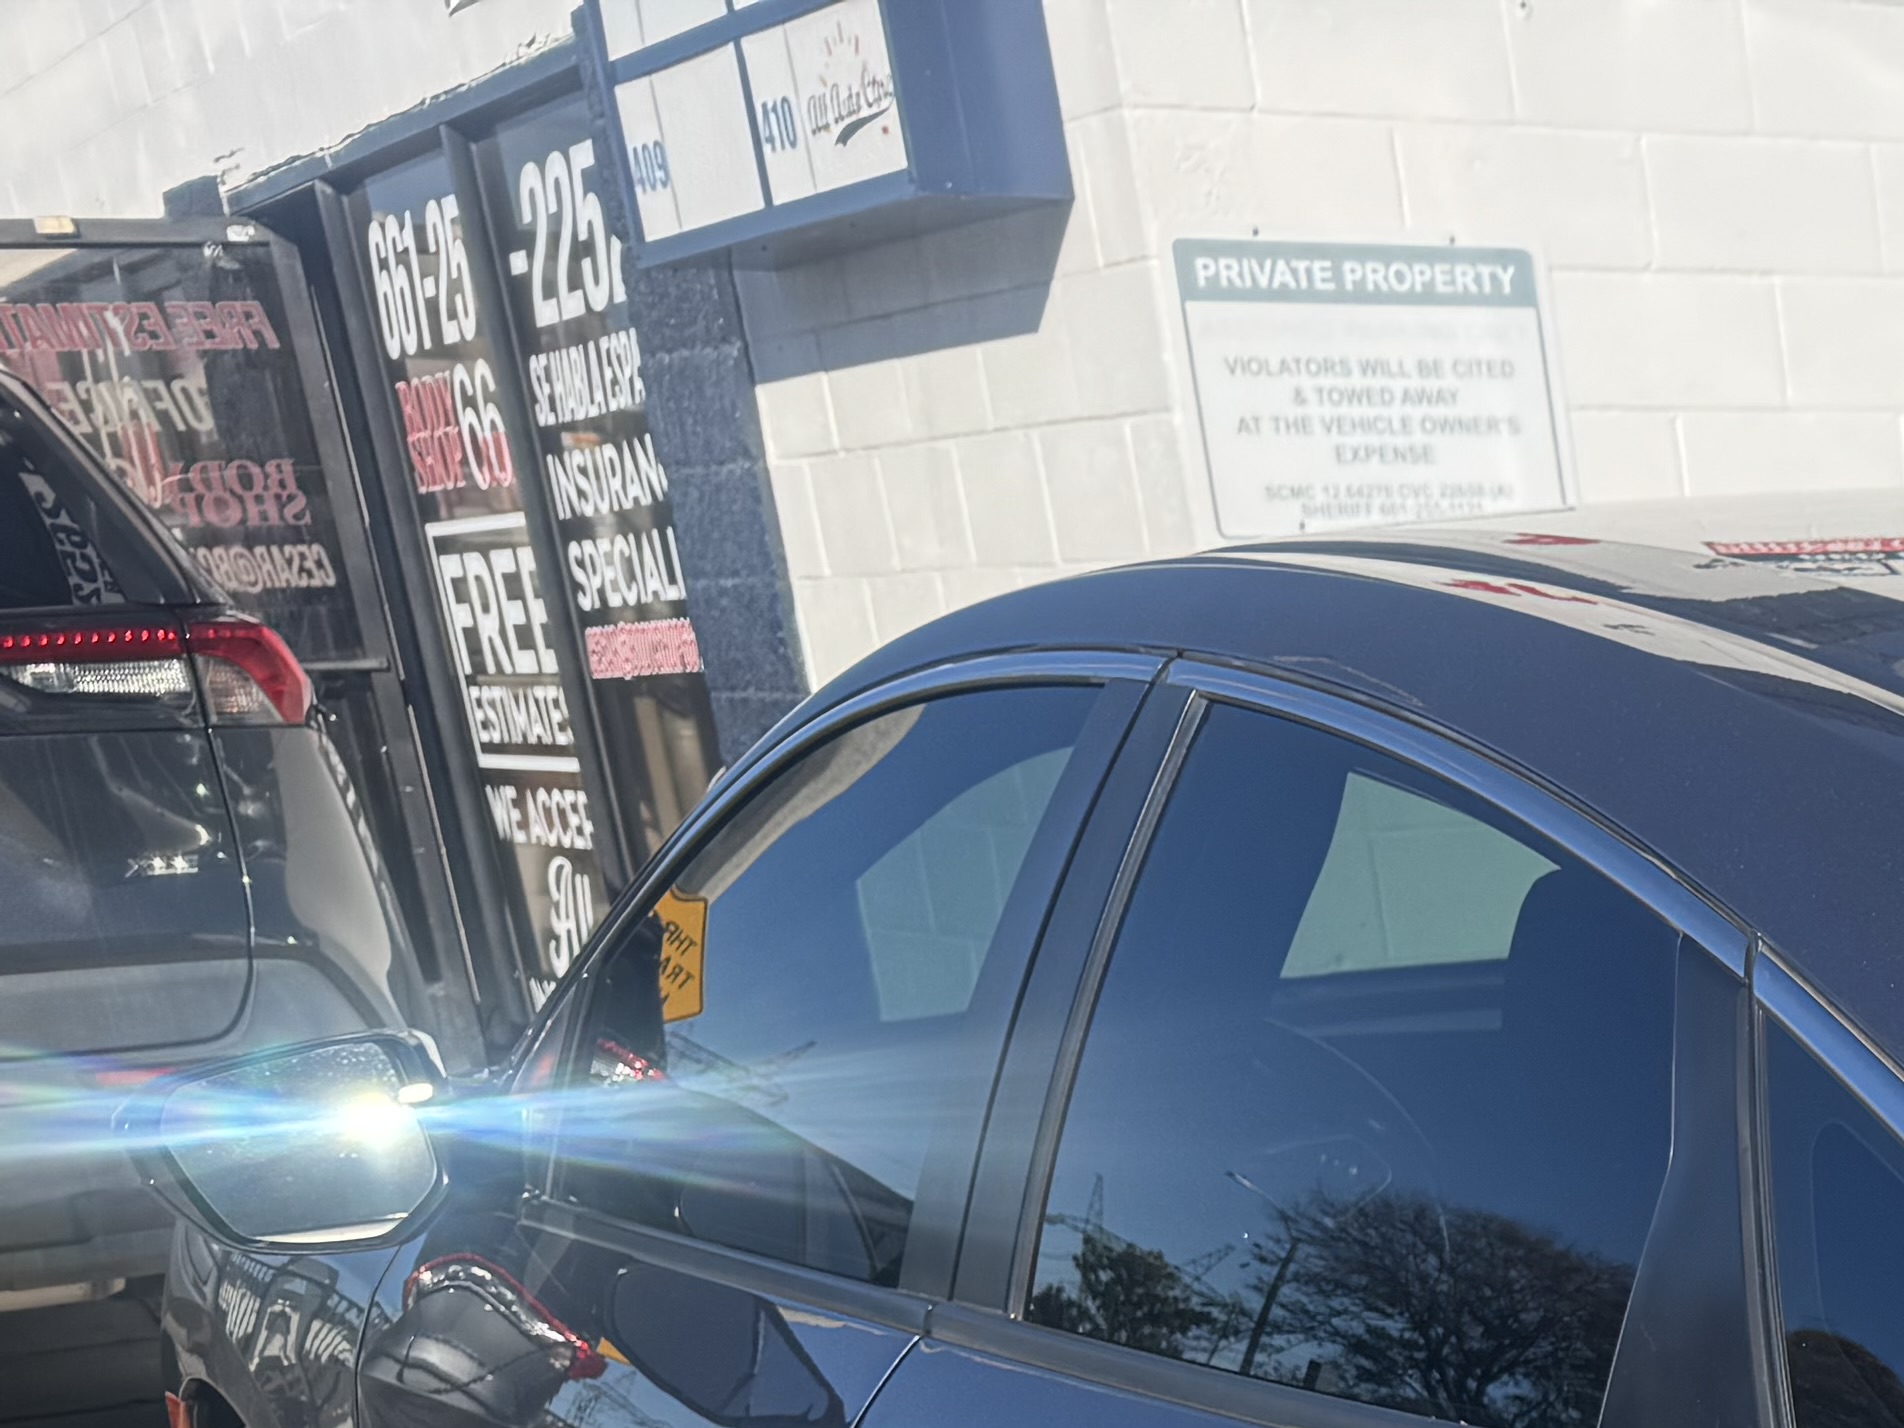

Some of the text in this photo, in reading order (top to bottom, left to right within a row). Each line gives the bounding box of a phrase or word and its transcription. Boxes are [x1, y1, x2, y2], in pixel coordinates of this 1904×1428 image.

[757, 95, 798, 154] 410
[631, 140, 669, 196] 409
[368, 194, 477, 360] 661-25
[1195, 257, 1515, 295] PRIVATE PROPERTY
[530, 328, 646, 427] SE HABLA ESPA
[1224, 356, 1515, 379] VIOLATORS WILL BE CITED
[396, 371, 454, 440] BODY
[454, 358, 514, 491] 66
[1237, 416, 1521, 438] AT THE VEHICLE OWNER'S
[1294, 387, 1459, 408] & TOWED AWAY
[1336, 444, 1436, 466] EXPENSE
[569, 527, 686, 611] SPECIALI
[485, 785, 594, 850] WE ACCEP
